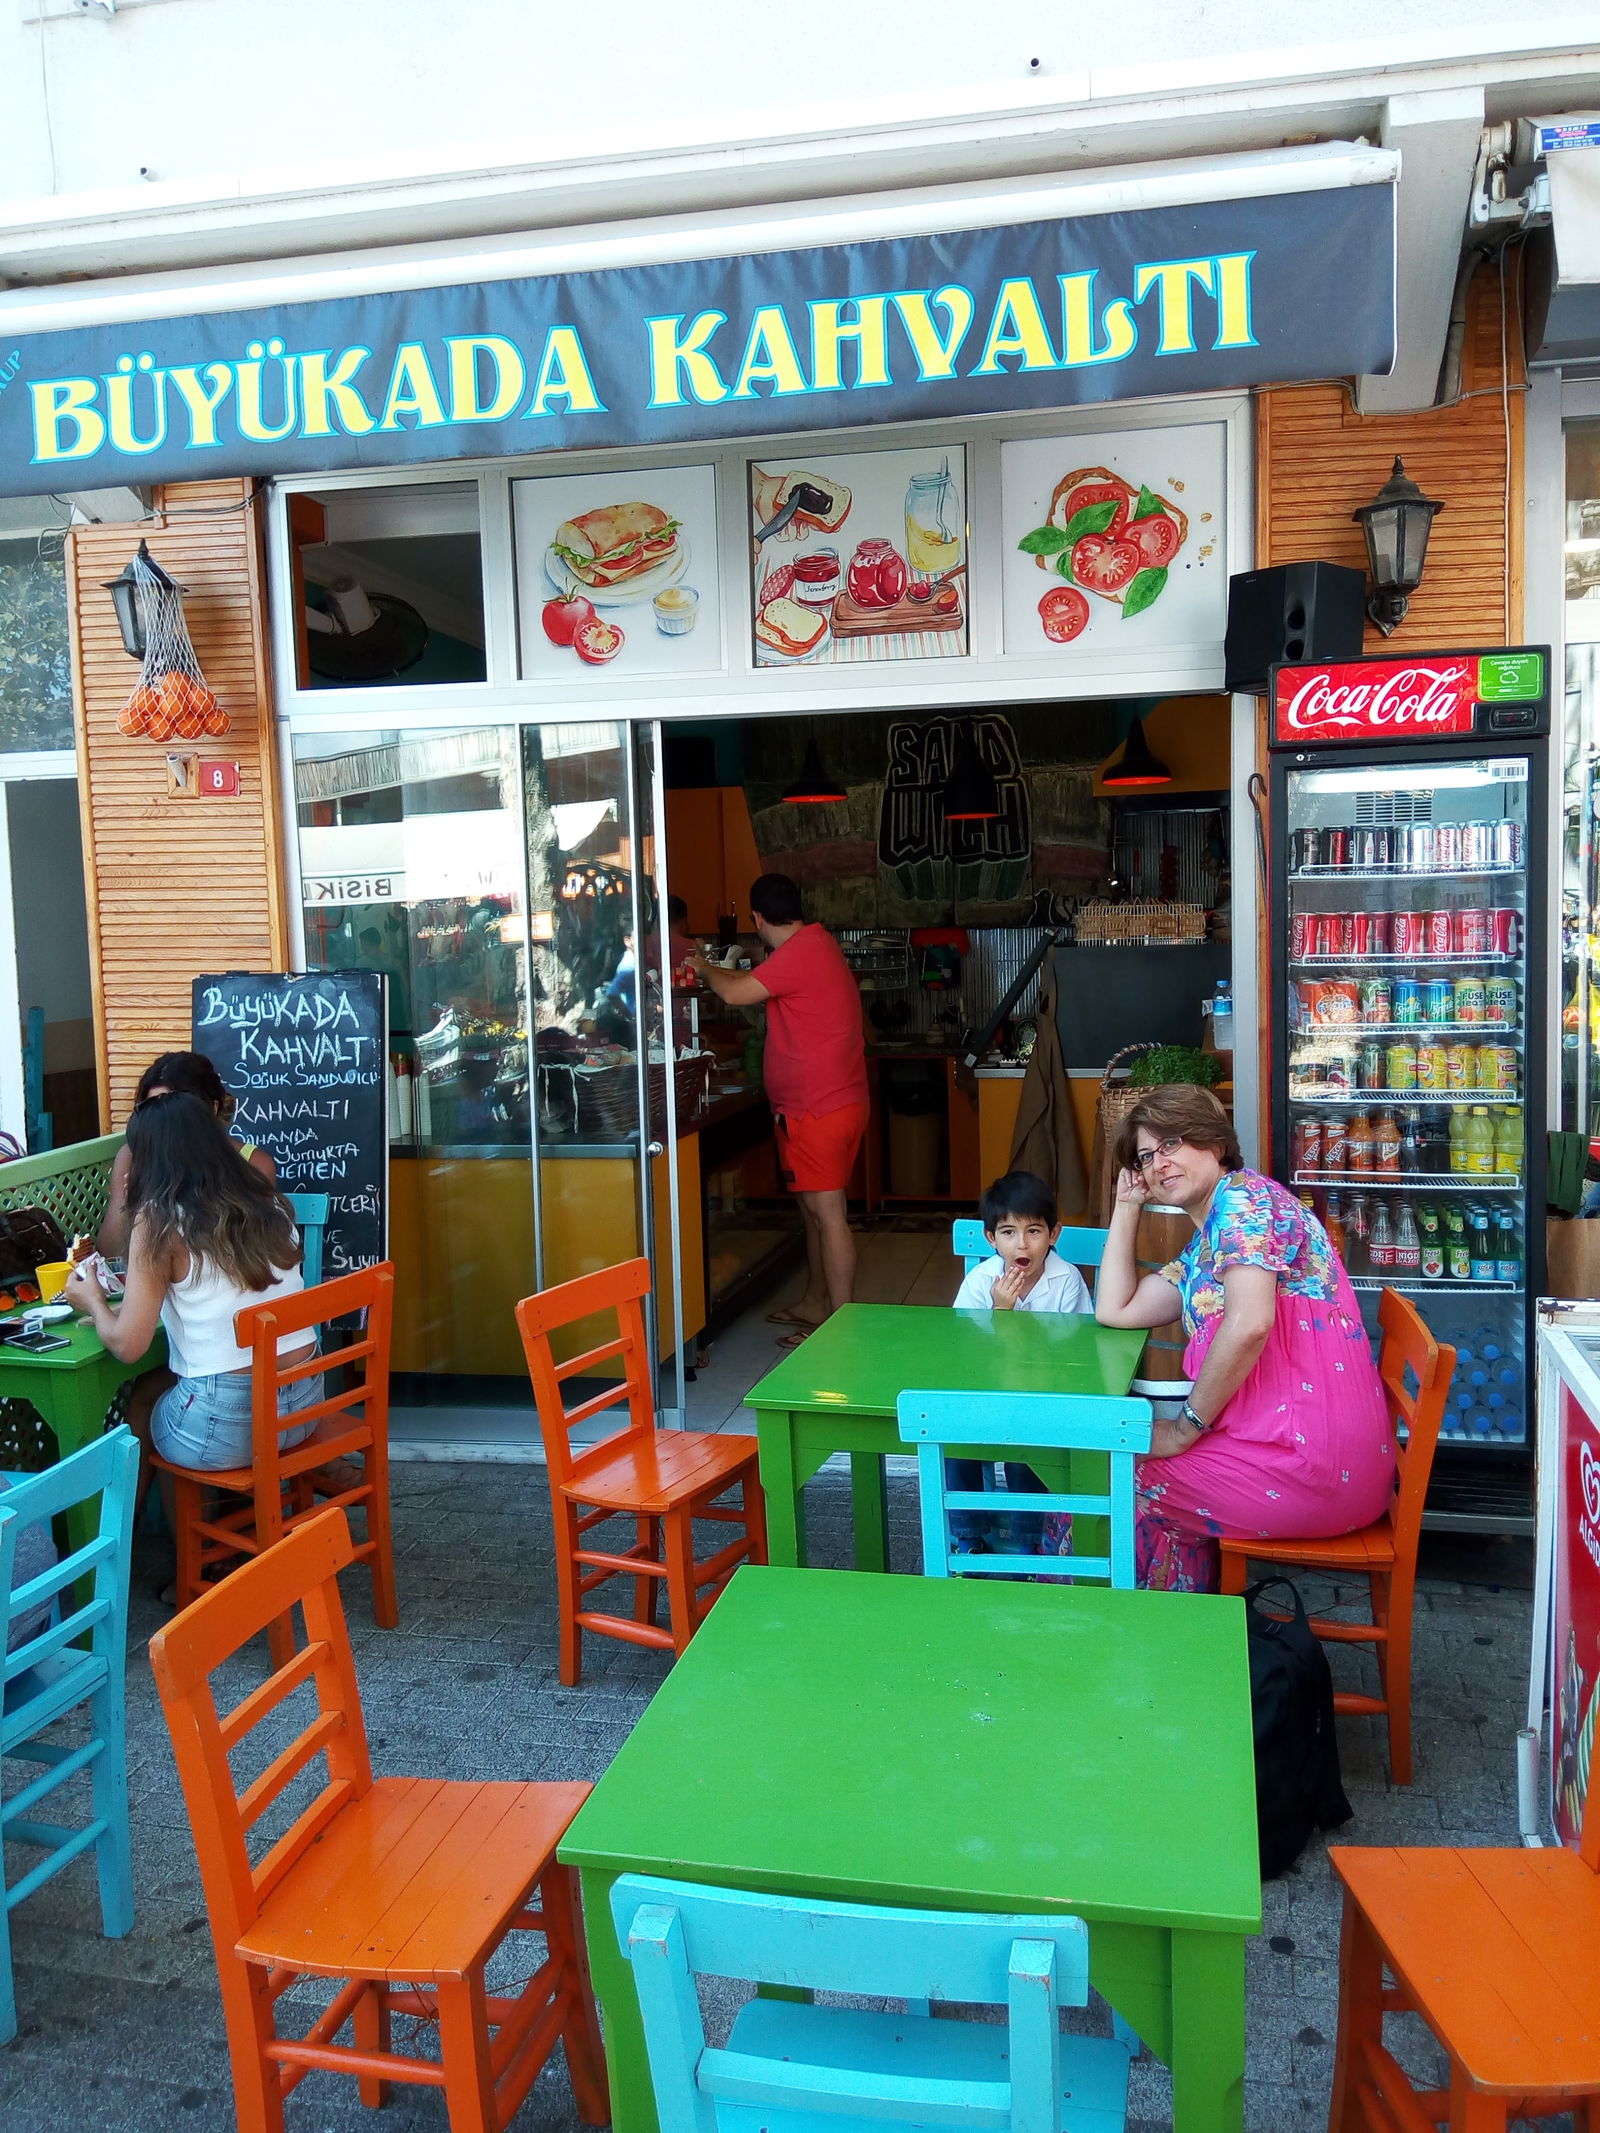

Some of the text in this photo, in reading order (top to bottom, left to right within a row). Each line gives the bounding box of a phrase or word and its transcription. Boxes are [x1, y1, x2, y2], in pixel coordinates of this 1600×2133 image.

[29, 249, 1261, 465] BÜYÜKADA KAHVALTI
[1288, 667, 1468, 729] Coca-Cola
[213, 769, 223, 788] 8
[1462, 992, 1483, 1001] FUSE
[1490, 991, 1512, 1000] FUSE
[233, 1097, 350, 1123] KAHVALTI
